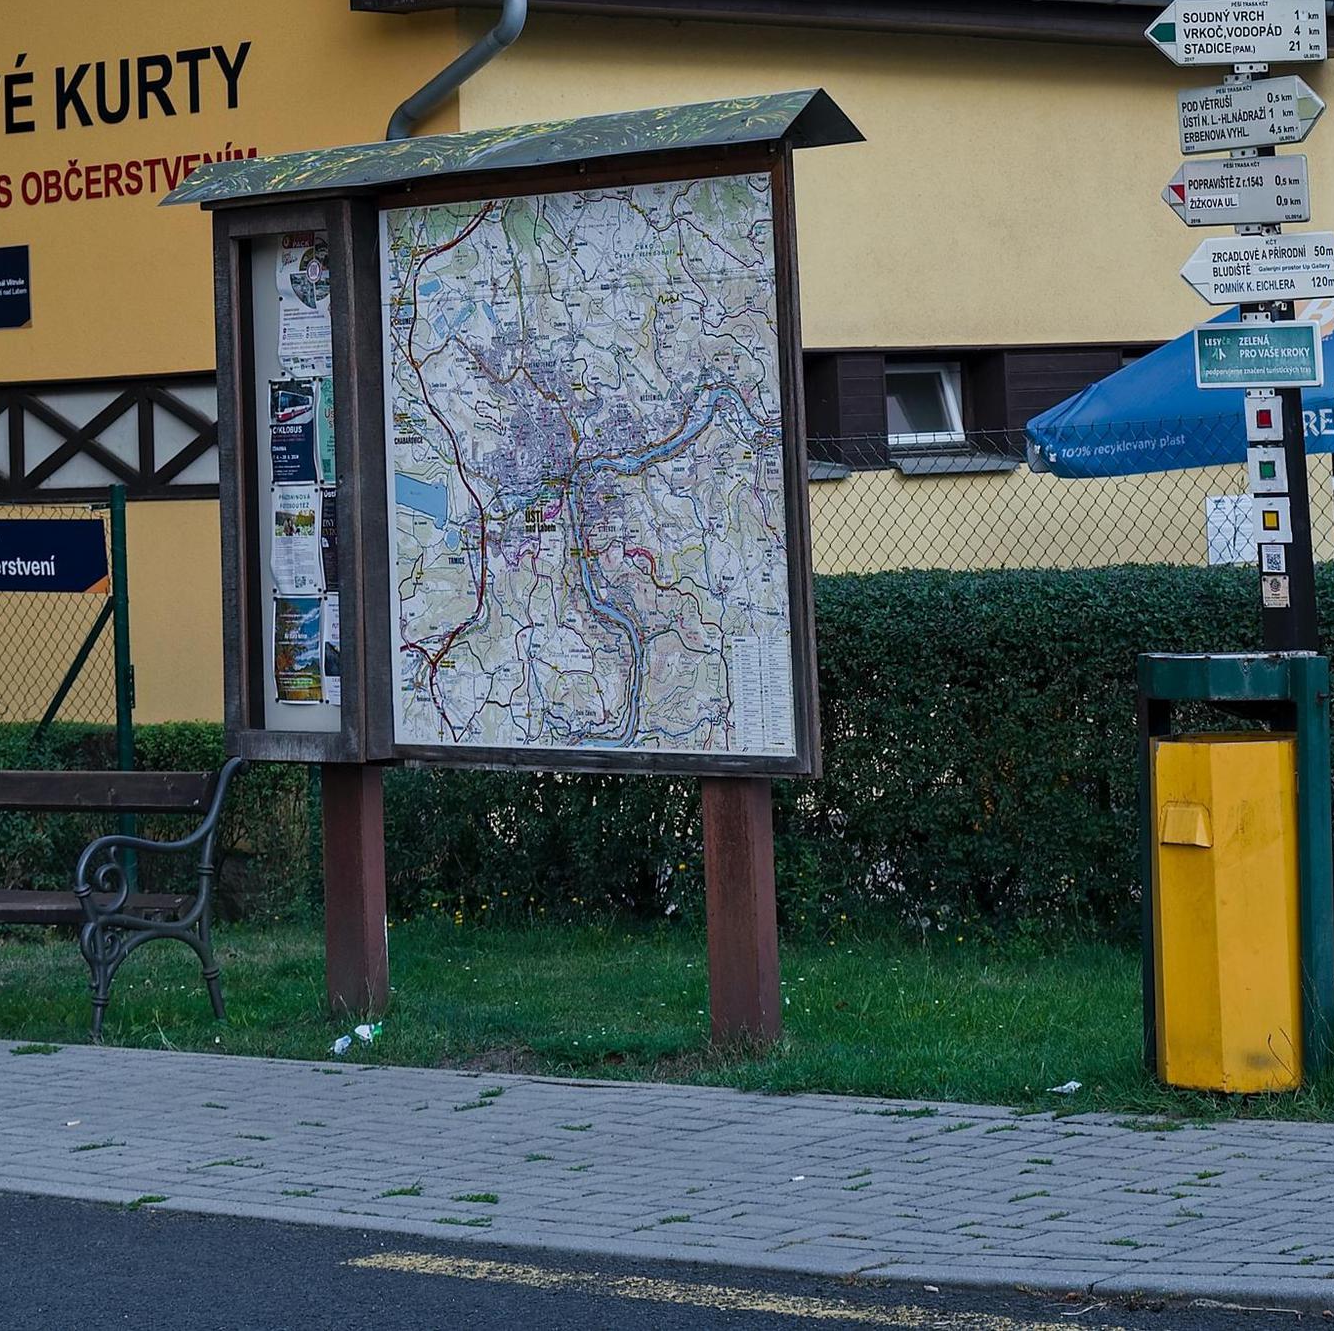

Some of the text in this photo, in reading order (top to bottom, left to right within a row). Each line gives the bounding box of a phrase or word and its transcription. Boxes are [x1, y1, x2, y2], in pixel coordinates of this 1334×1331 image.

[1182, 9, 1319, 23] SOUDNÝ VRCH 1 km
[1294, 24, 1301, 36] 4
[1308, 27, 1320, 36] km
[1289, 41, 1301, 51] 21
[1309, 43, 1320, 51] km
[55, 41, 252, 131] KURTY
[1181, 92, 1293, 113] POD VĚTRUŠÍ 0,5 km
[1183, 114, 1200, 128] ÚSTÍ
[1269, 108, 1274, 119] 1
[1282, 109, 1294, 117] km
[1184, 128, 1226, 143] ERBENOVA
[1269, 124, 1282, 135] 4,5
[1283, 124, 1294, 133] km
[1188, 175, 1235, 190] POPRAVIŠTĚ
[1242, 176, 1264, 188] r.1543
[1275, 175, 1287, 187] 0,5
[1288, 177, 1300, 185] km
[1189, 195, 1302, 210] ŽIŽKOVA UL. 0,9 km
[1212, 249, 1260, 263] ZRCADLOVÉ
[1261, 250, 1267, 260] A
[1268, 244, 1307, 259] PŘÍRODNÍ
[1212, 264, 1252, 278] BLUDIŠTĚ
[1213, 279, 1245, 294] POMNÍK
[1246, 281, 1255, 292] K.
[1256, 278, 1296, 291] EICHLERA
[1238, 334, 1270, 346] ZELENÁ
[1239, 346, 1310, 358] PRO VAŠE KROKY
[1159, 434, 1186, 450] plast
